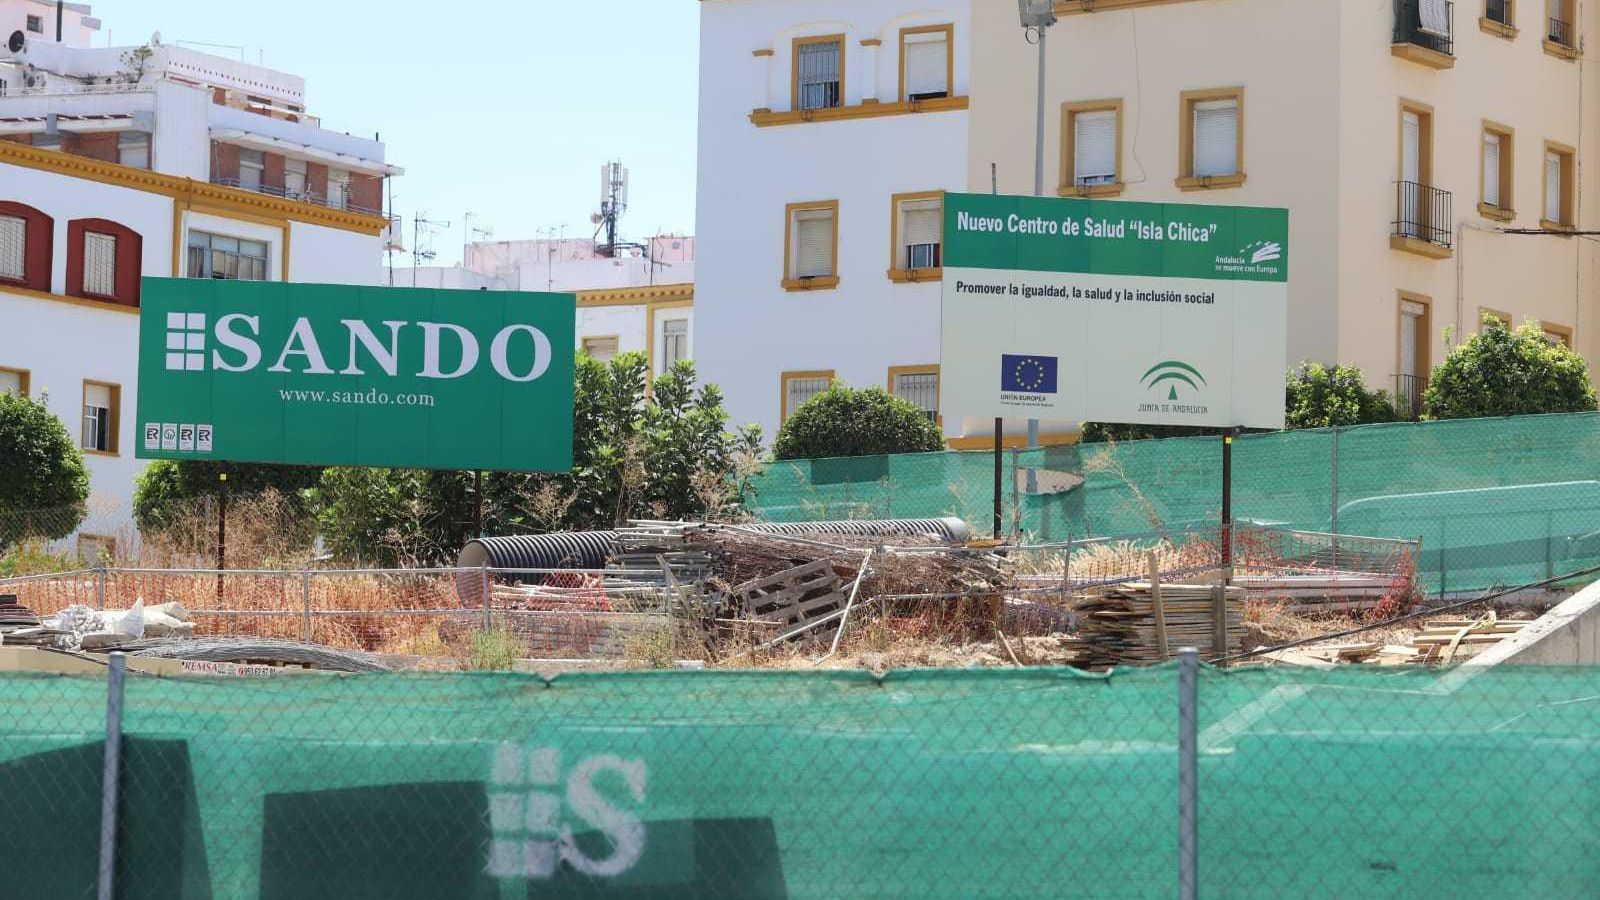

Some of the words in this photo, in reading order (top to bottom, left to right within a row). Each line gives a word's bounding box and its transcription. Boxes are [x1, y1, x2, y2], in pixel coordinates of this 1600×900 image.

[957, 211, 1003, 232] Nuevo
[1007, 213, 1058, 235] Centro
[1062, 216, 1080, 236] de
[1084, 217, 1125, 238] Salud
[1256, 264, 1278, 274] Europa
[956, 280, 1006, 295] Promover
[1009, 283, 1019, 295] la
[1021, 283, 1069, 299] igualdad,
[1072, 286, 1082, 298] la
[1085, 287, 1112, 300] salud
[1114, 291, 1121, 303] y
[1124, 289, 1133, 301] la
[1136, 289, 1182, 302] inclusión
[1184, 291, 1215, 304] social
[212, 313, 553, 382] SANDO
[279, 388, 436, 406] www.sando.com
[1137, 403, 1160, 413] JUNTA
[1161, 404, 1169, 413] DE
[184, 661, 218, 672] REMSA
